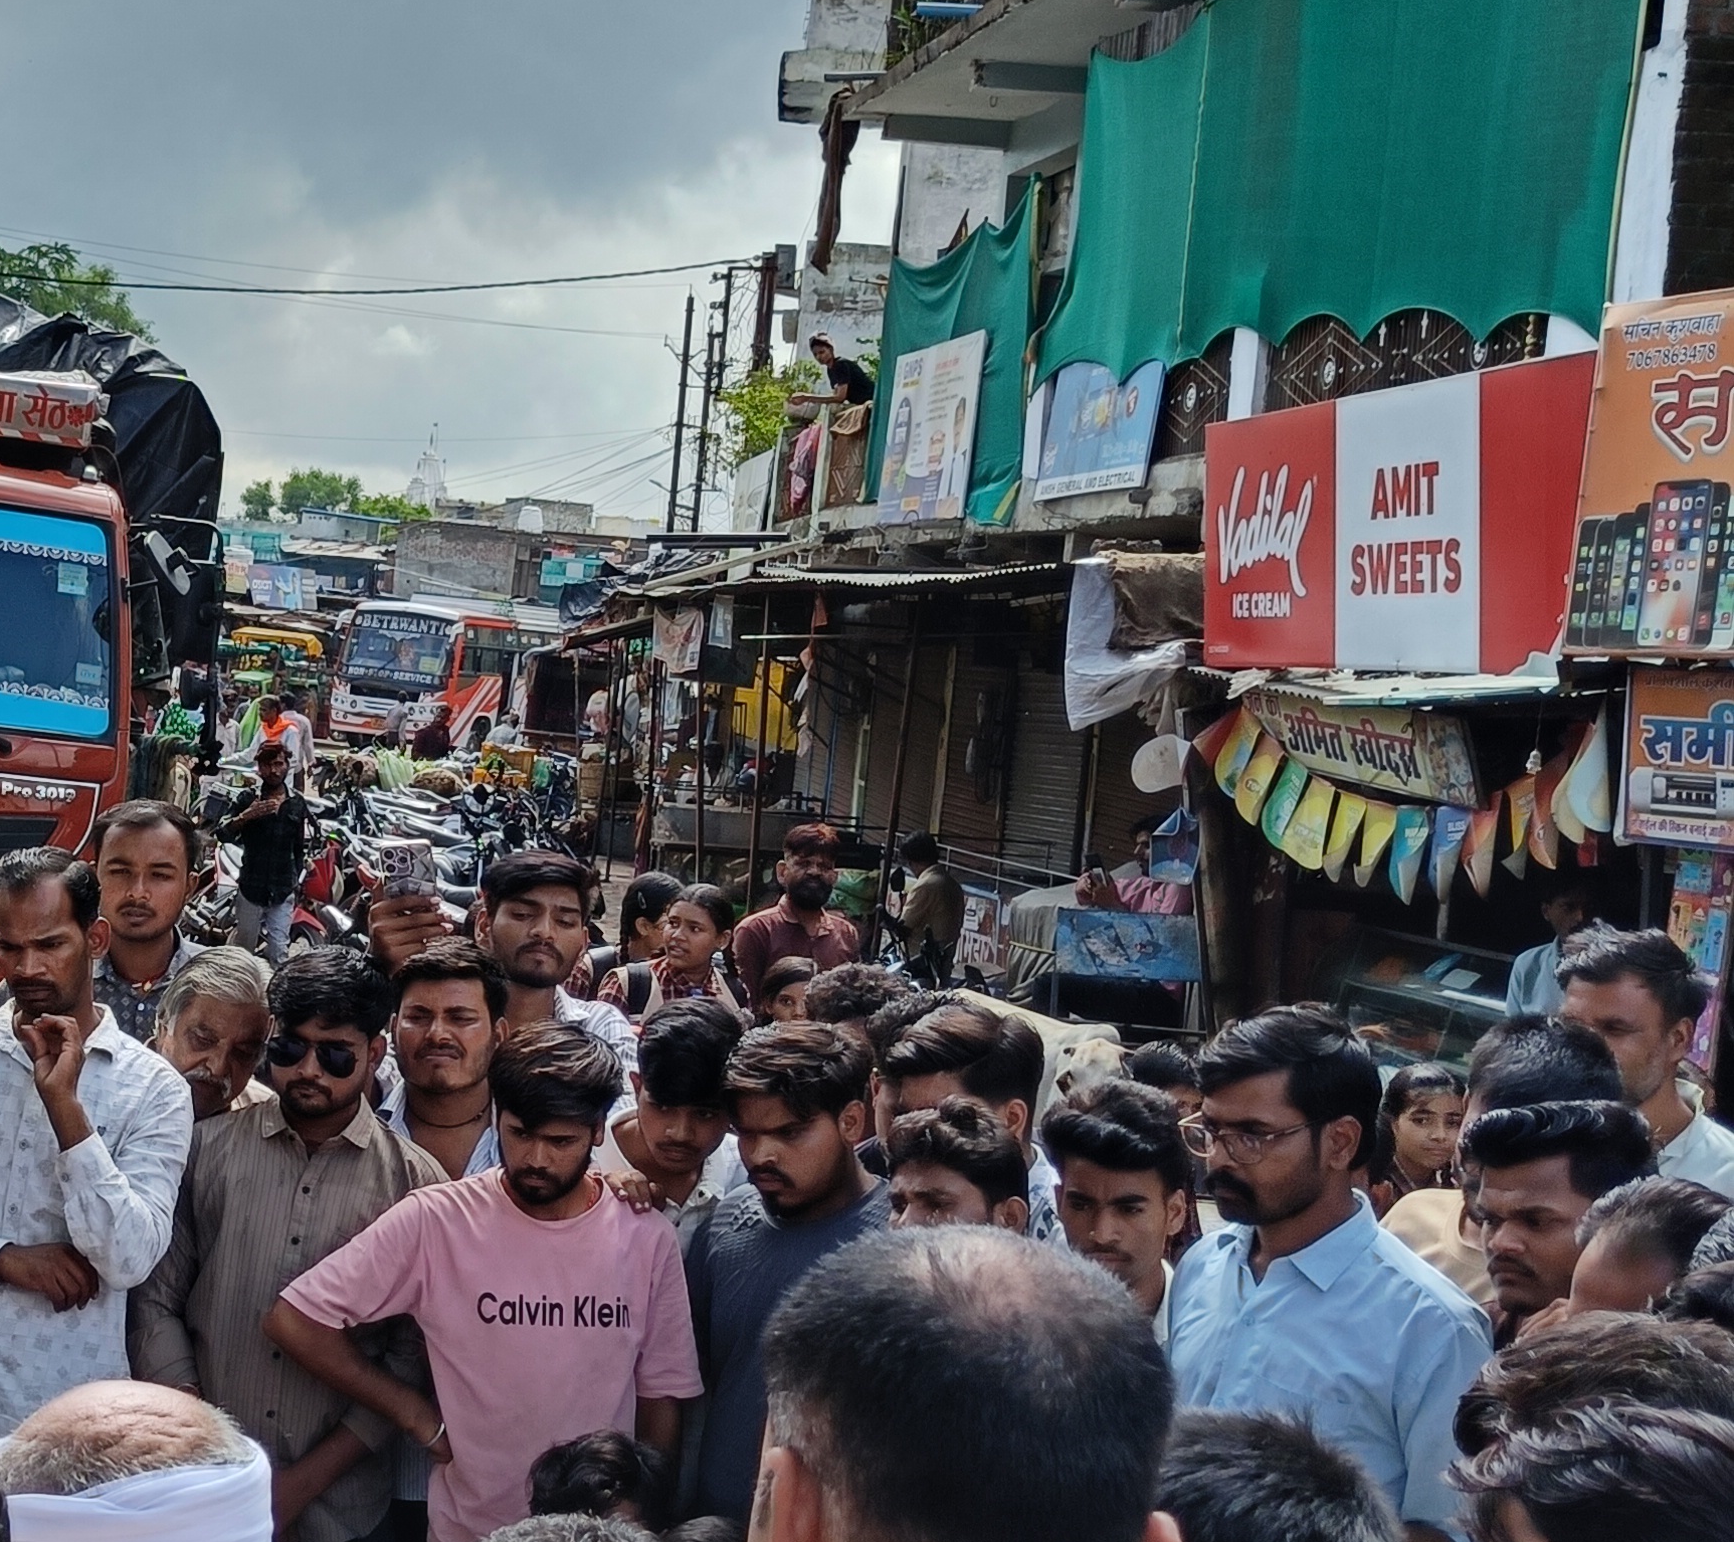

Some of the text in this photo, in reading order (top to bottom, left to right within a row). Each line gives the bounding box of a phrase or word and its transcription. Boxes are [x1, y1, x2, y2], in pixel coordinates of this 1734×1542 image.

[1623, 317, 1662, 342] सचिन
[1626, 342, 1717, 370] 7067863478
[22, 384, 70, 430] सेठ
[1370, 461, 1439, 520] AMIT
[1217, 463, 1313, 598] Vadilal
[1350, 537, 1462, 596] SWEETS
[1231, 592, 1291, 618] ICE CREAM
[1283, 706, 1348, 763] अमित
[1, 780, 33, 798] Pro
[477, 1292, 631, 1329] Calvin Klein
